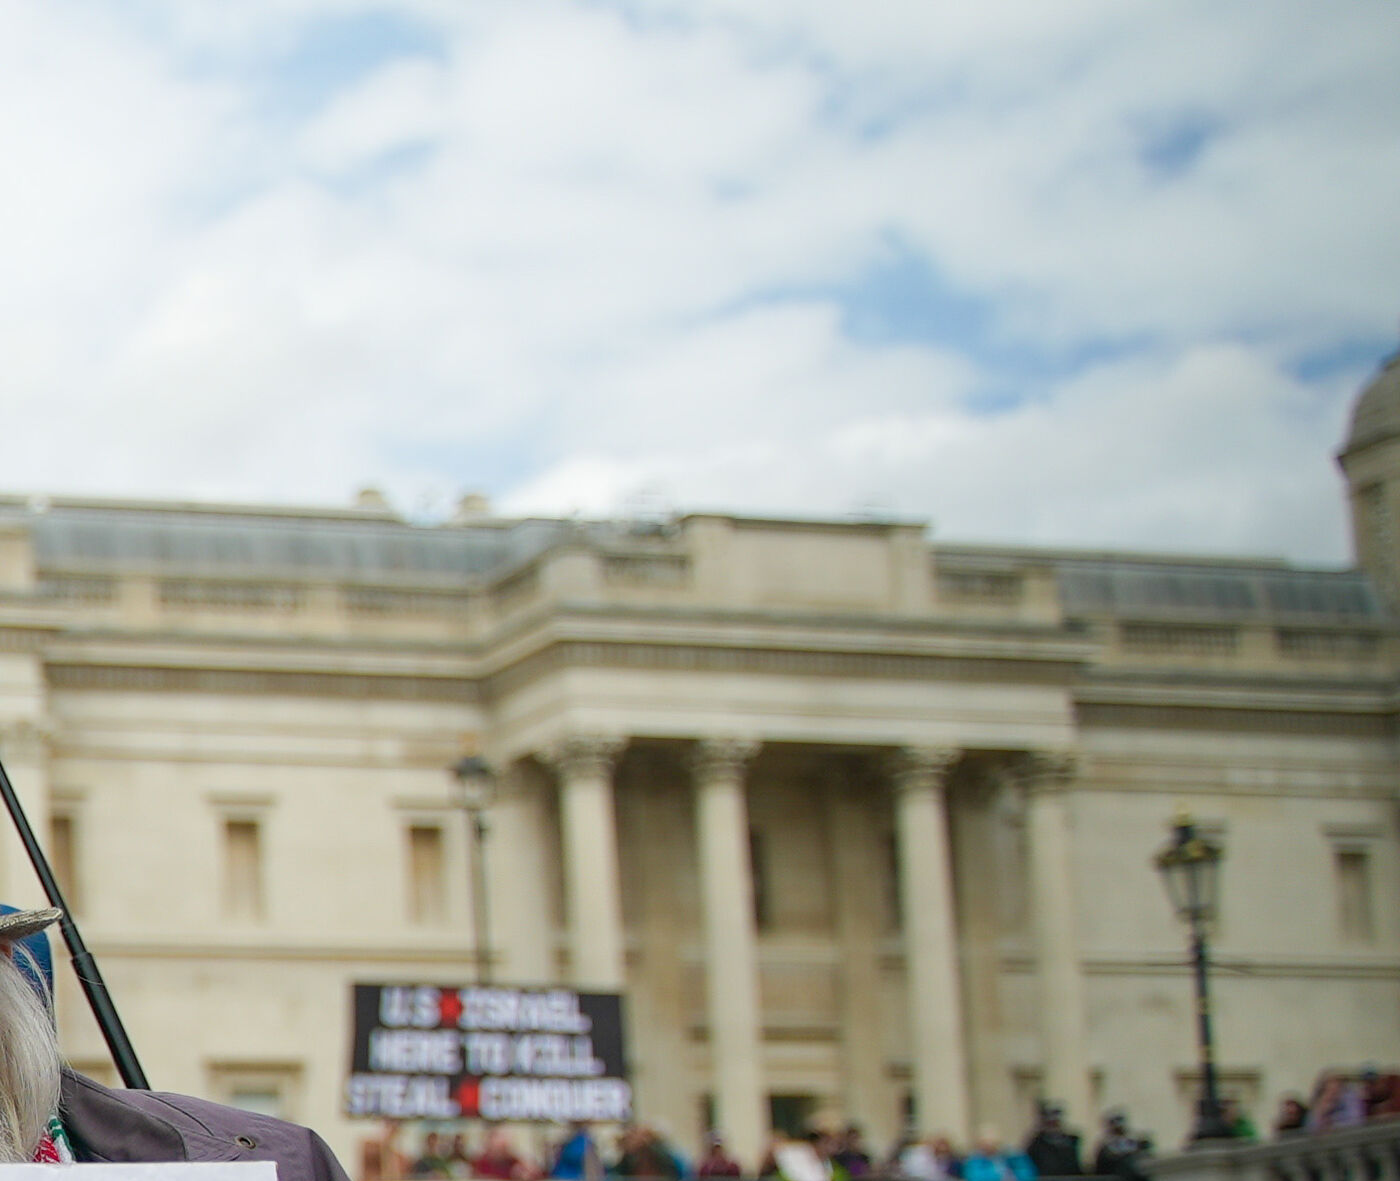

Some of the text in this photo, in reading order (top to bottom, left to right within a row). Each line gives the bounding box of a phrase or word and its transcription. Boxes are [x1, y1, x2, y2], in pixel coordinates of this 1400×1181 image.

[465, 1031, 511, 1075] TO
[348, 1072, 632, 1122] STEAL CONQUER
